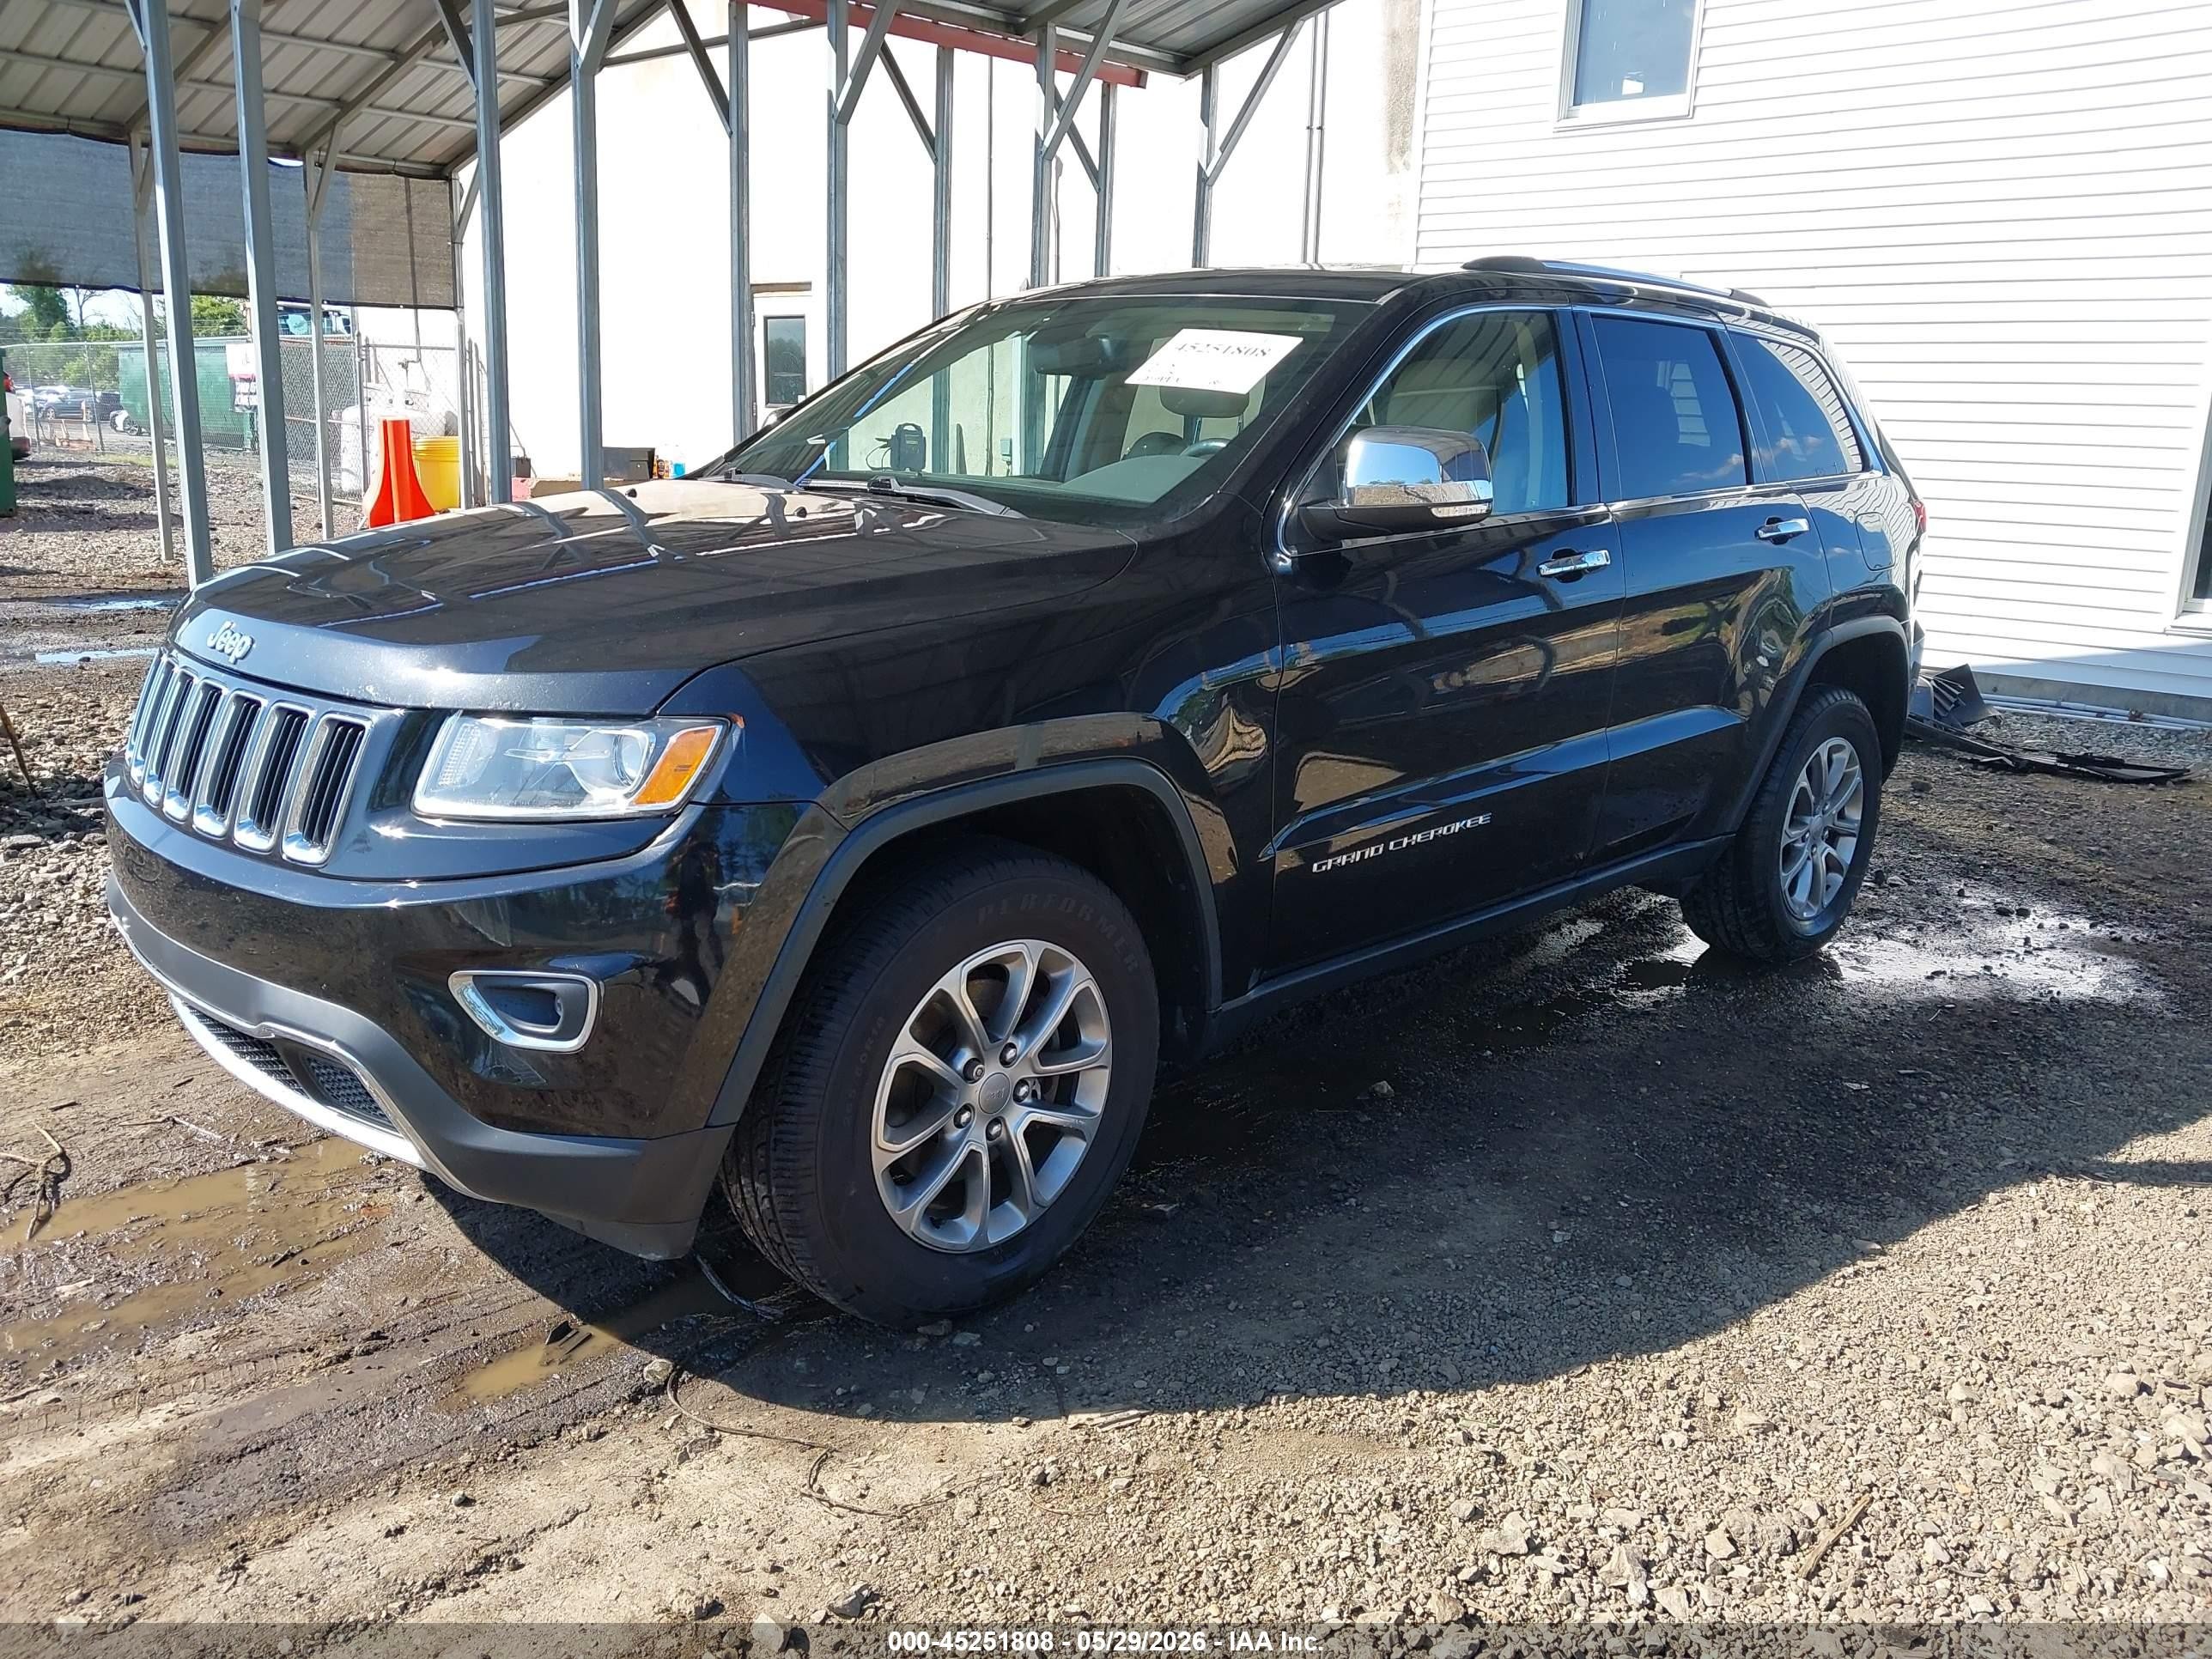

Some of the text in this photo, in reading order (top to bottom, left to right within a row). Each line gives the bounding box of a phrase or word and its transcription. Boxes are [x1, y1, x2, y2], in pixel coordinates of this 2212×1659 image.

[206, 620, 255, 665] Jeep
[1311, 811, 1493, 874] GRAND CHEROKEE
